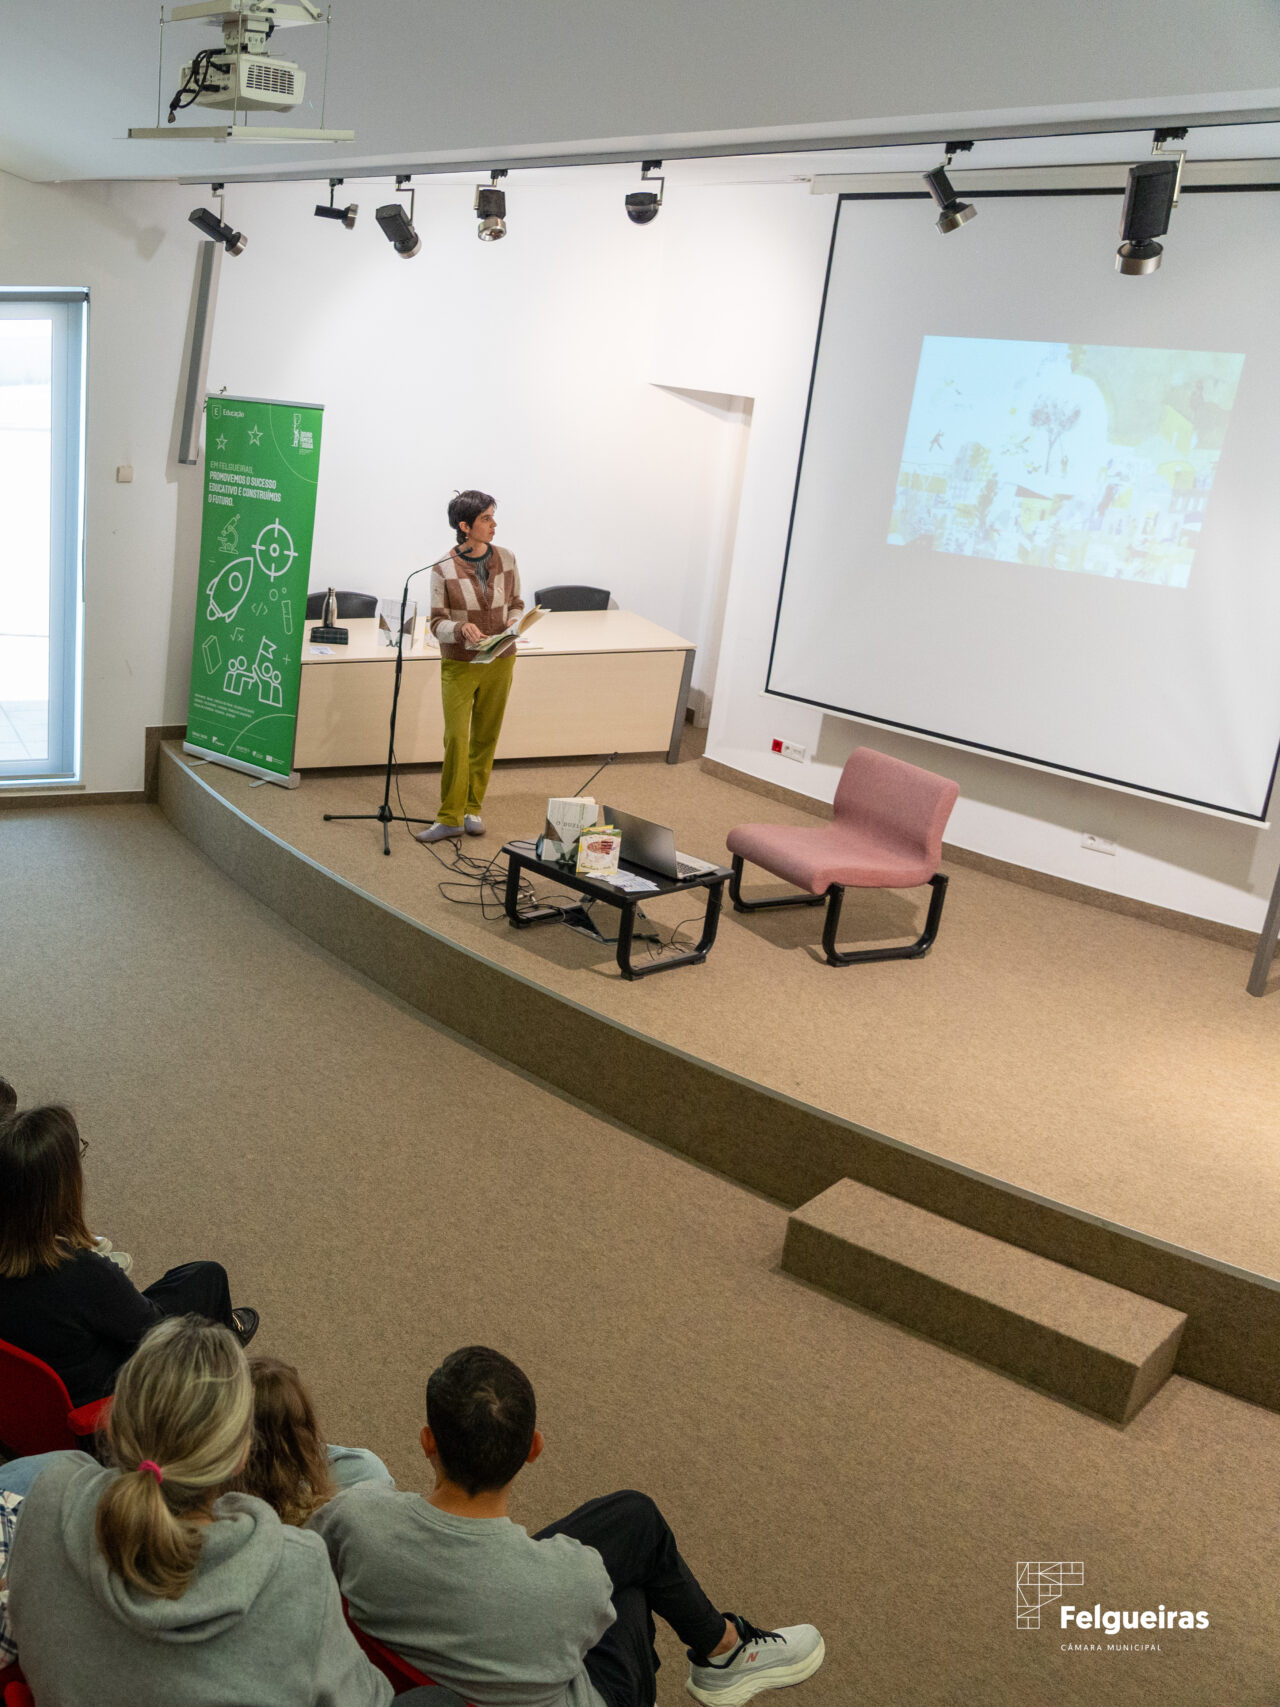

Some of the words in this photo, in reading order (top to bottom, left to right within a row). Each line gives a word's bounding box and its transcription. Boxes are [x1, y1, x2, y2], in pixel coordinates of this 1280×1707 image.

[223, 409, 245, 417] Educação
[210, 461, 219, 470] EM
[209, 471, 246, 485] PROMOVEMOS
[246, 477, 250, 485] O
[251, 477, 277, 489] SUCESSO
[209, 482, 238, 495] EDUCATIVO
[238, 487, 242, 496] E
[242, 488, 282, 502] CONSTRUÍMOS
[208, 494, 212, 503] O
